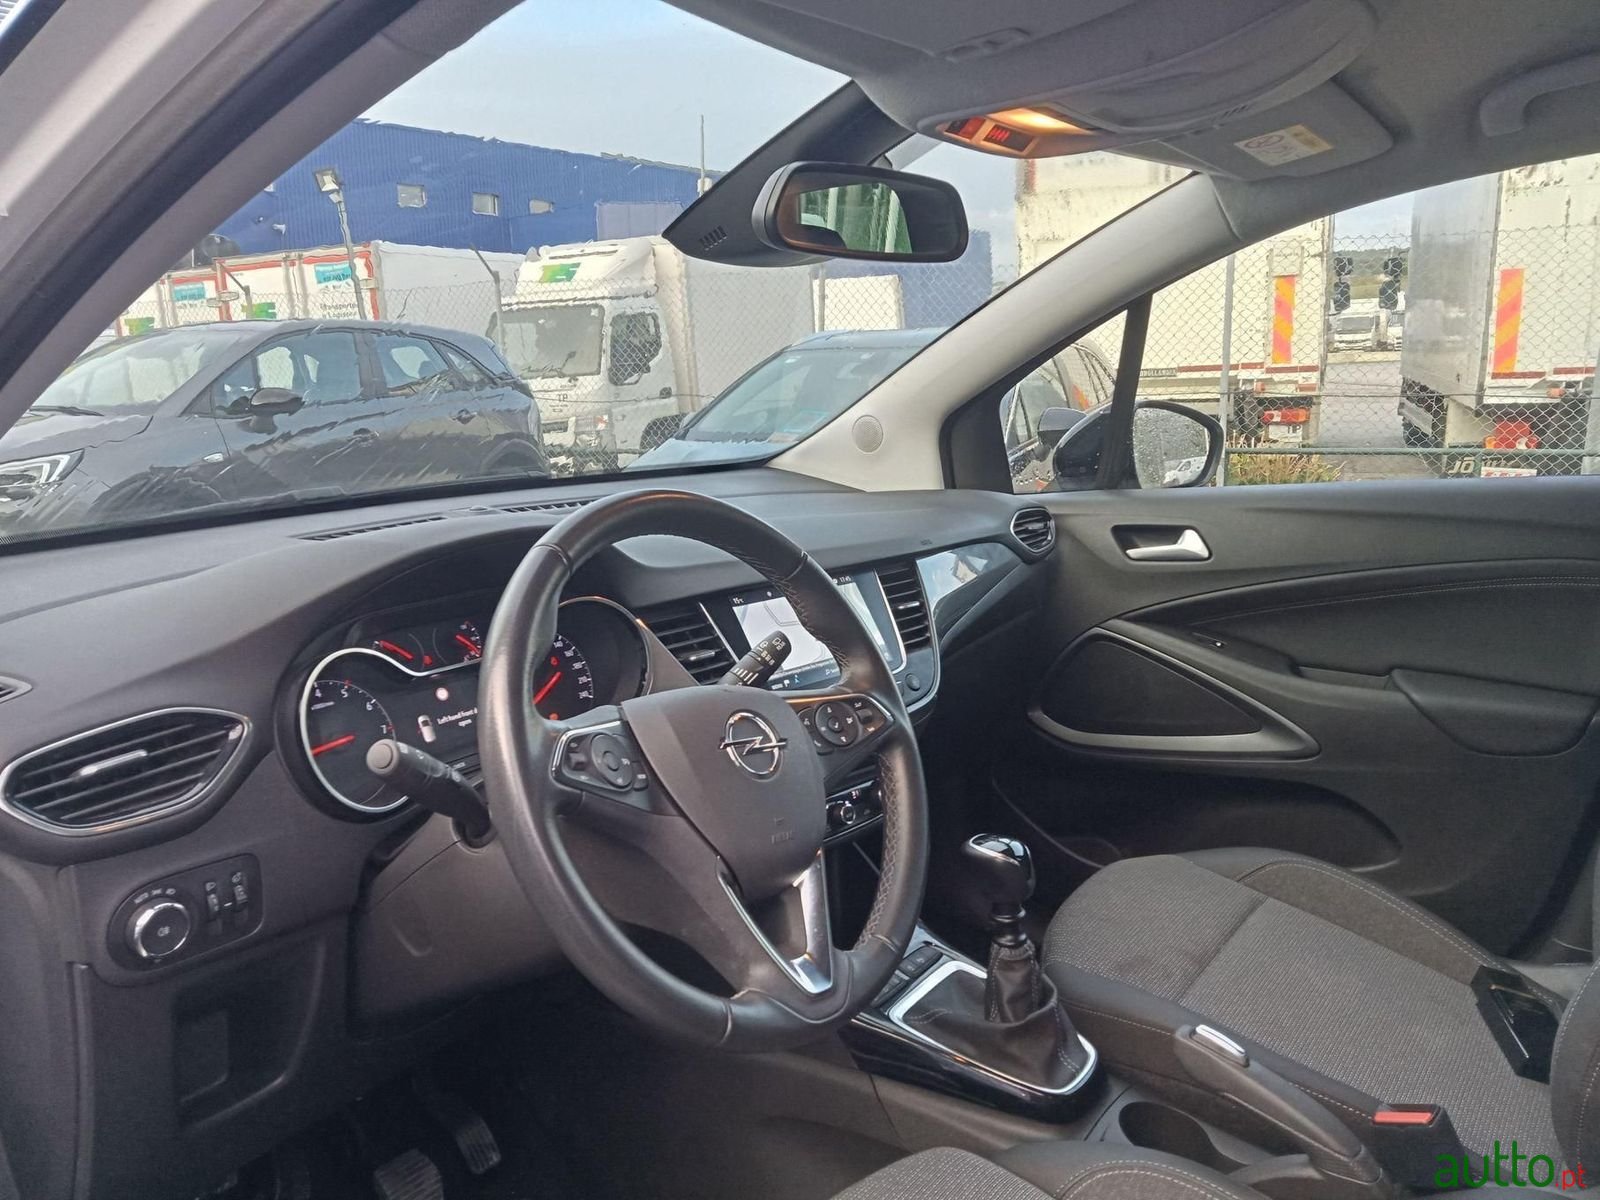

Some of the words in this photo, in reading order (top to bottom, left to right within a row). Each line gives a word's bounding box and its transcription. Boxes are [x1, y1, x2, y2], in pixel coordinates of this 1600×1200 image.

[340, 688, 348, 698] 5
[366, 701, 373, 711] 6
[380, 725, 387, 734] 7
